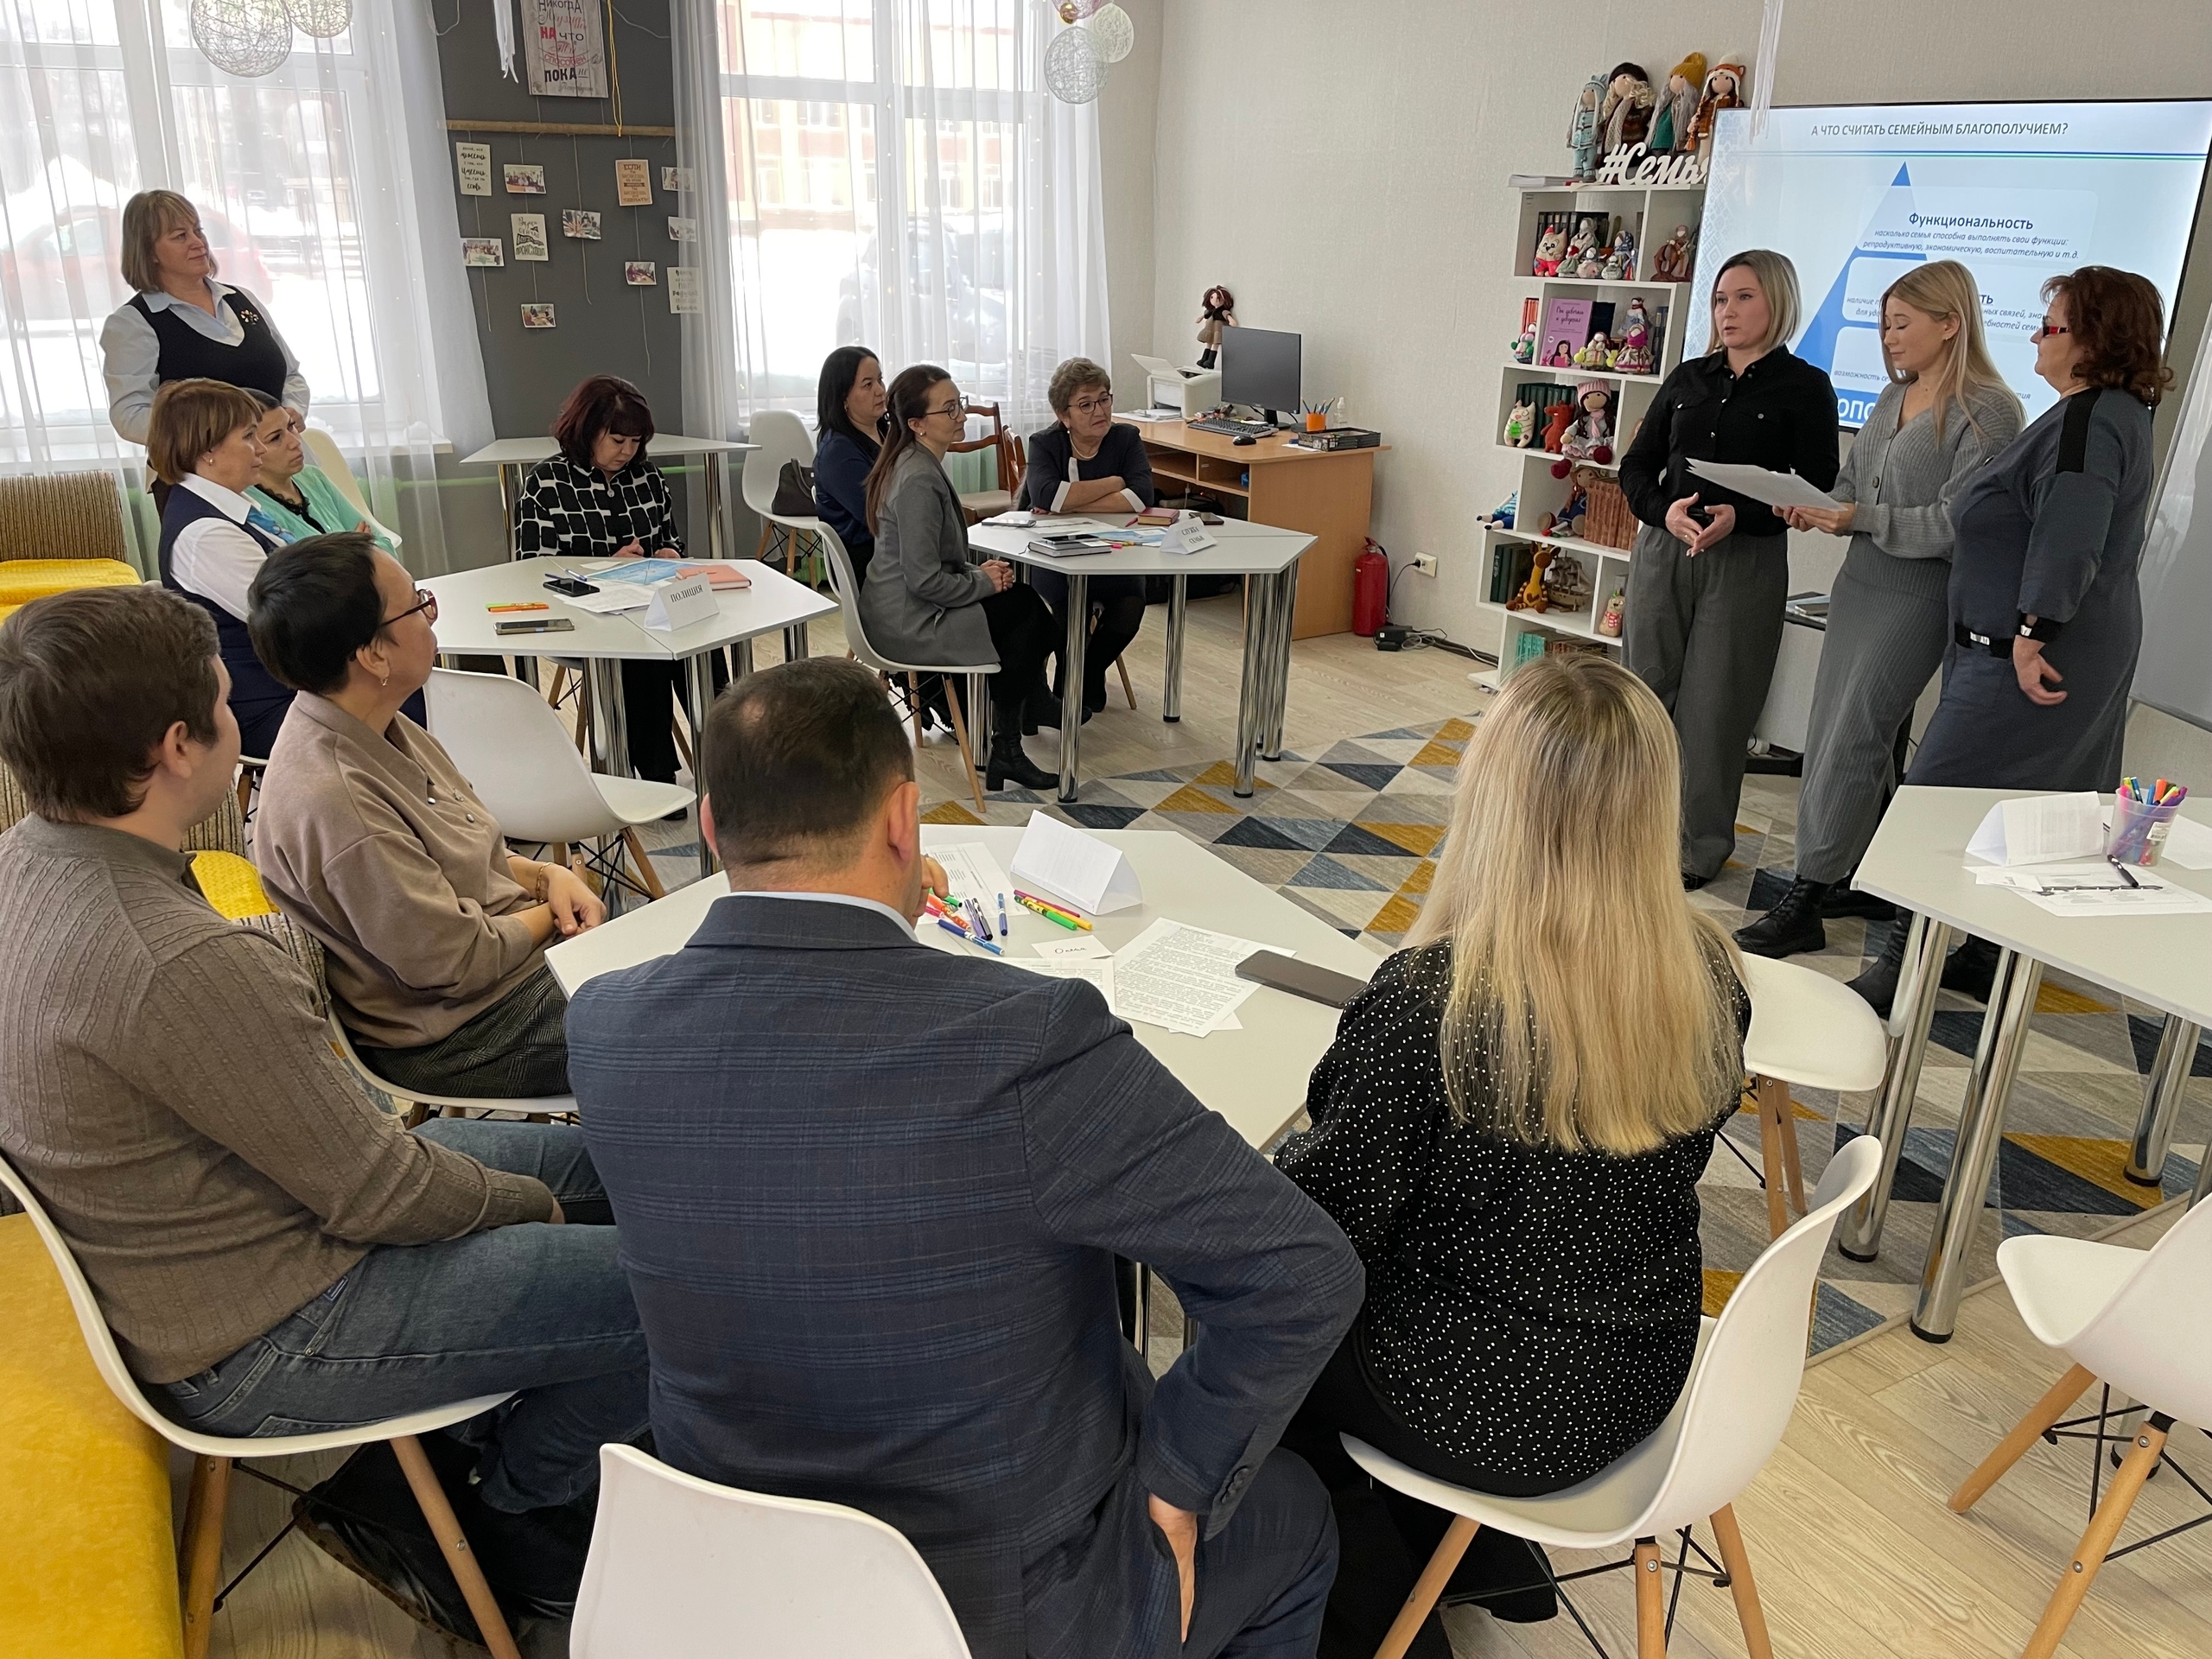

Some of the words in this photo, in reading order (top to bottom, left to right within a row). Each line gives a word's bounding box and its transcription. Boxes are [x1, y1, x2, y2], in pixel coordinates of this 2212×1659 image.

[544, 67, 577, 83] ПОКА
[1811, 125, 1819, 137] А
[1821, 124, 1840, 136] ЧТО
[1841, 124, 1885, 136] СЧИТАТЬ
[1887, 121, 1954, 135] СЕМЕЙНЫМ
[1955, 122, 2069, 135] БЛАГОПОЛУЧИЕМ?
[1909, 213, 2034, 230] Функциональность
[1932, 232, 1966, 240] способна
[1967, 233, 2011, 243] выполнять
[2012, 235, 2030, 244] свои
[2031, 236, 2069, 246] функции:
[1863, 240, 1923, 251] репродуктивную,
[1925, 244, 1983, 255] экономическую,
[1984, 247, 2054, 258] воспитательную
[2062, 250, 2079, 259] т.д.
[1856, 307, 1868, 315] для
[1999, 309, 2026, 319] связей,
[1834, 370, 1880, 381] возможность
[670, 584, 703, 603] ПОЛИЦИЯ
